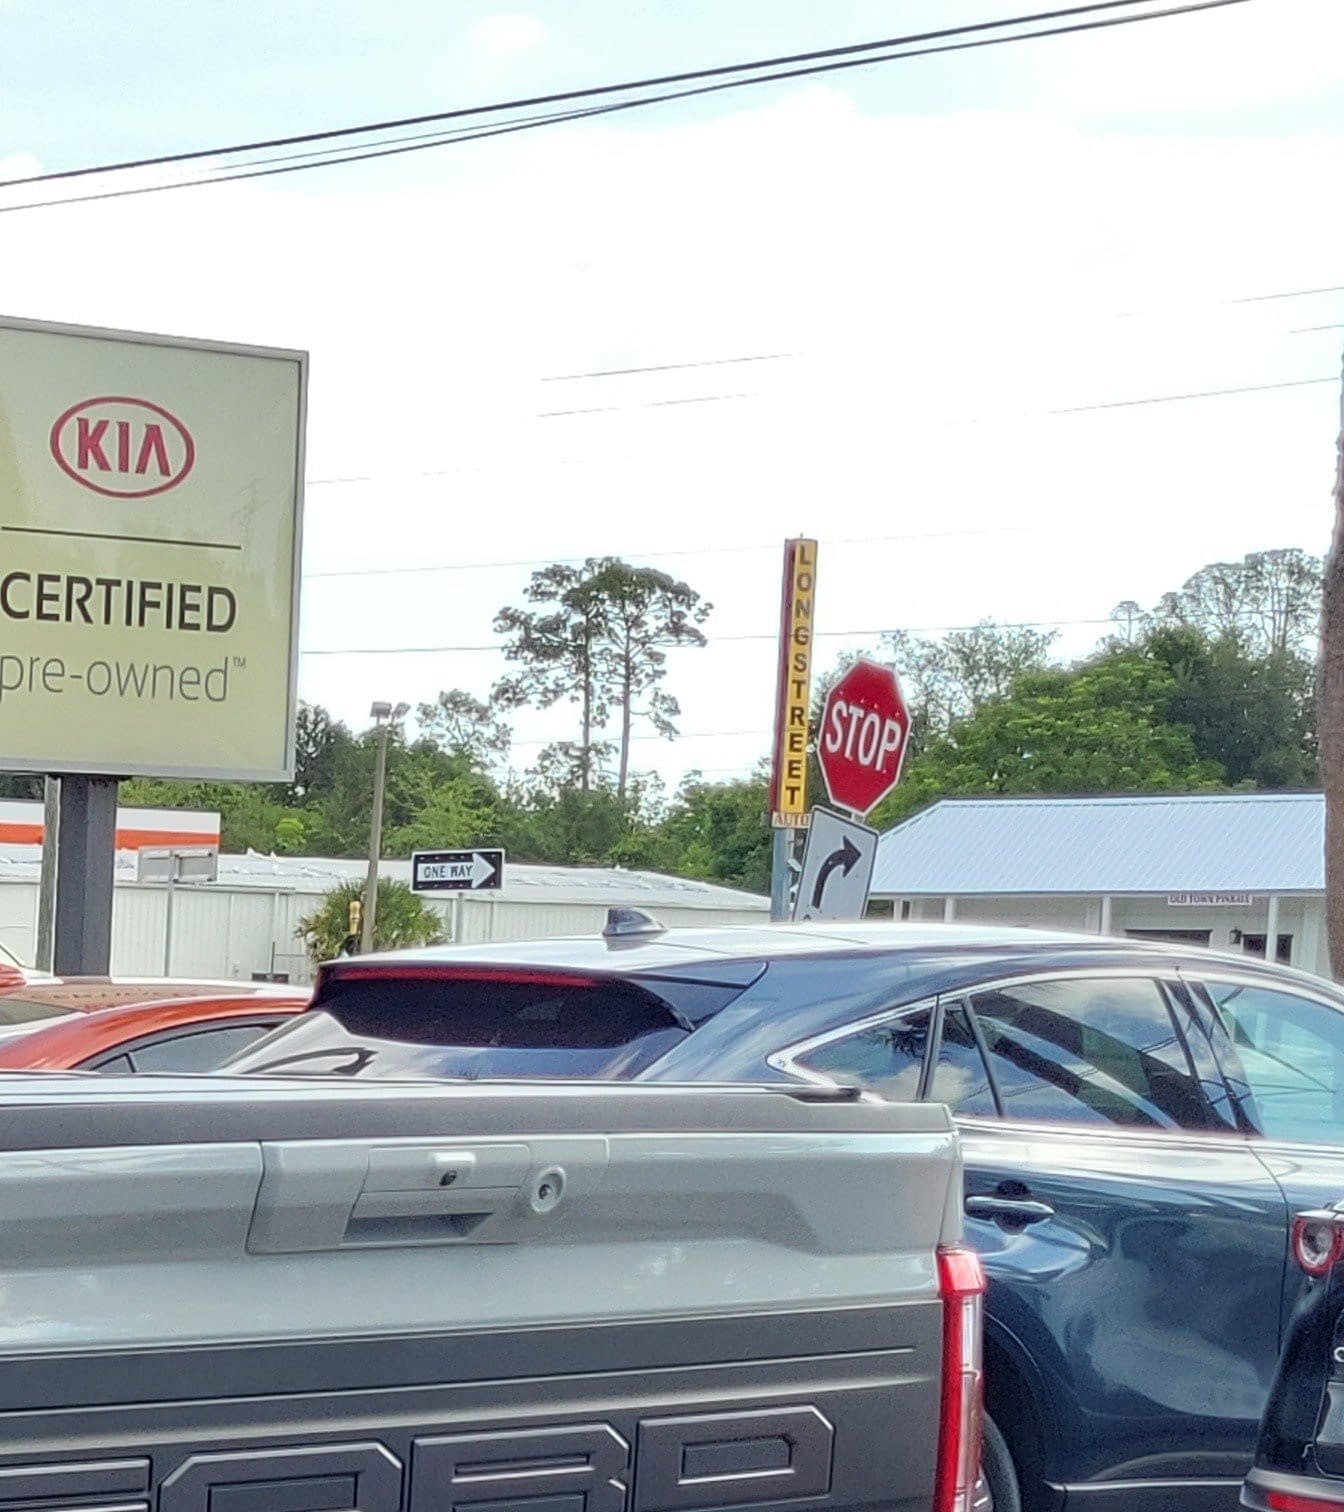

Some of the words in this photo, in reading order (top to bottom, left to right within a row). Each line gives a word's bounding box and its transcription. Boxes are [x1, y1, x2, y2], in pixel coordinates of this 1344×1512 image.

[76, 416, 171, 478] KIA
[0, 571, 238, 633] CERTIFIED
[785, 545, 812, 806] LONGSTREET
[825, 700, 902, 773] STOP
[774, 812, 810, 827] AUTO
[423, 865, 446, 879] ONE
[450, 863, 473, 878] WAY
